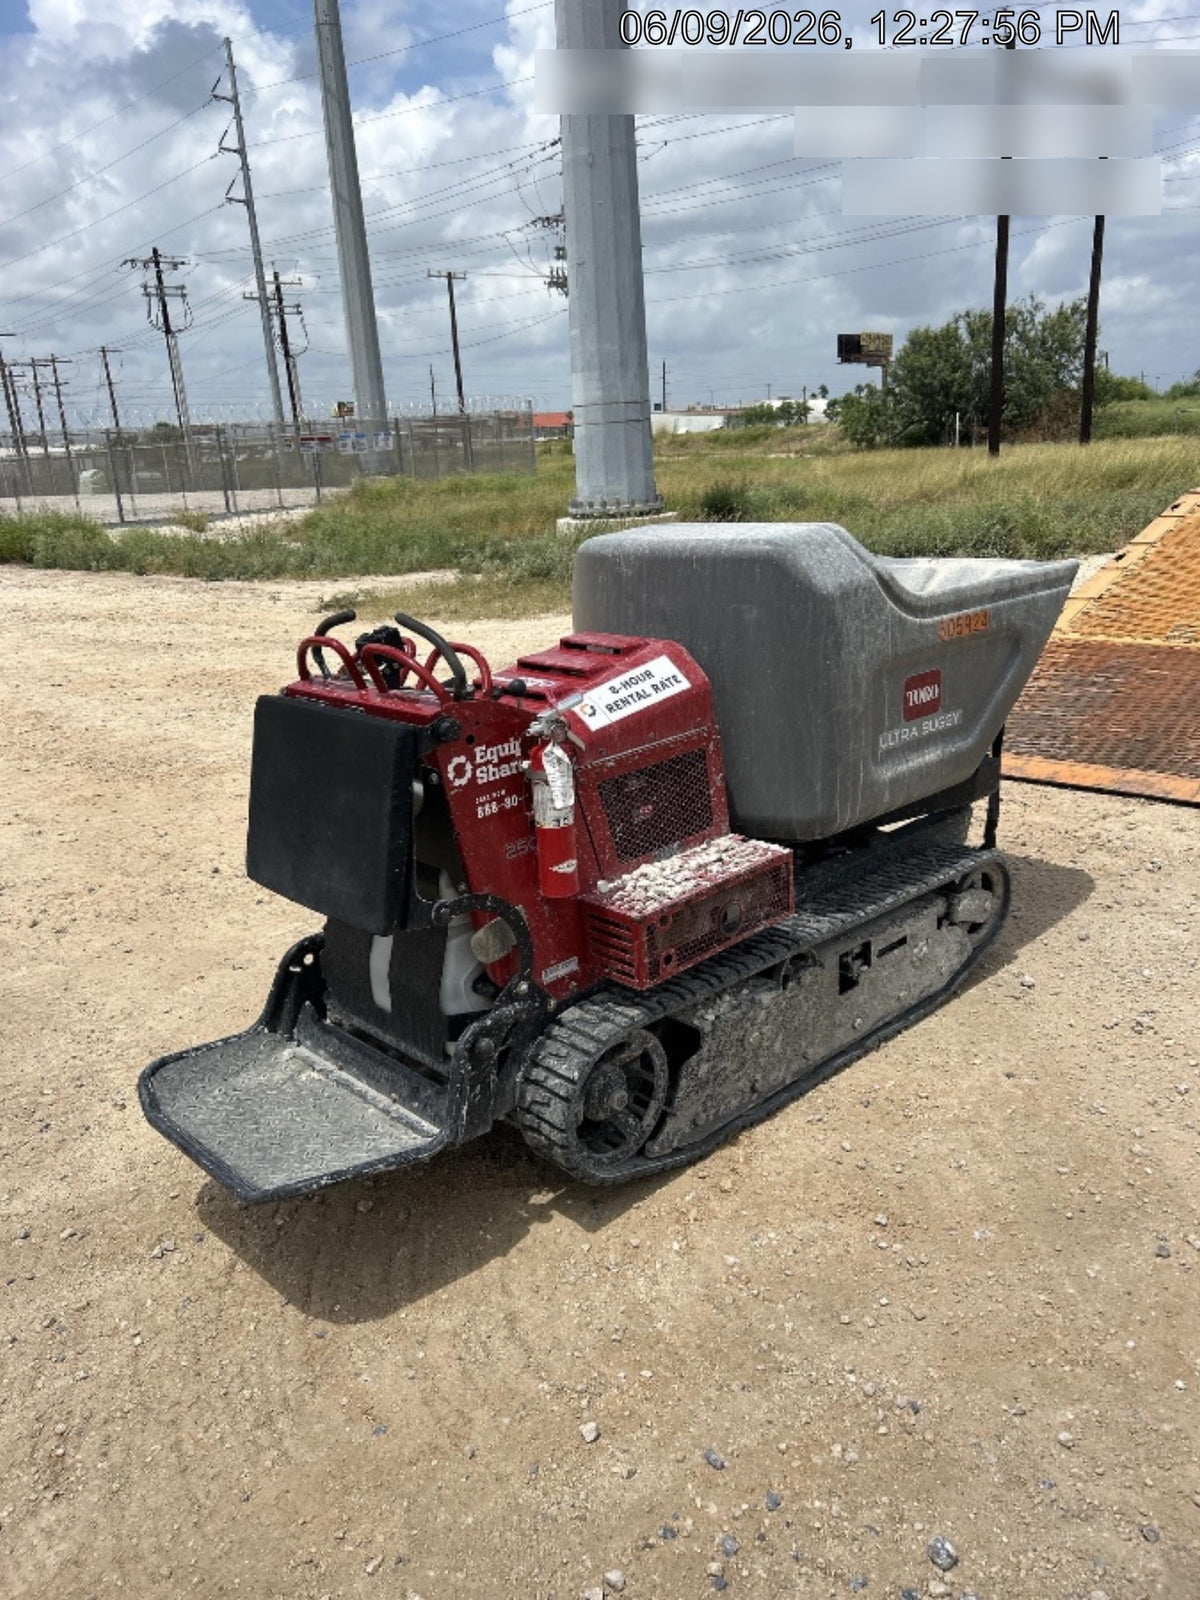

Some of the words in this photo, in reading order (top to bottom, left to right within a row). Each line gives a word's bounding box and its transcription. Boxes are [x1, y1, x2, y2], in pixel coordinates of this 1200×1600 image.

[604, 689, 652, 714] RENTAL
[651, 674, 682, 694] RATE
[608, 669, 655, 694] 8-HOUR
[906, 684, 939, 706] TORO
[880, 727, 918, 750] ULTRA
[922, 709, 961, 735] BUGGY
